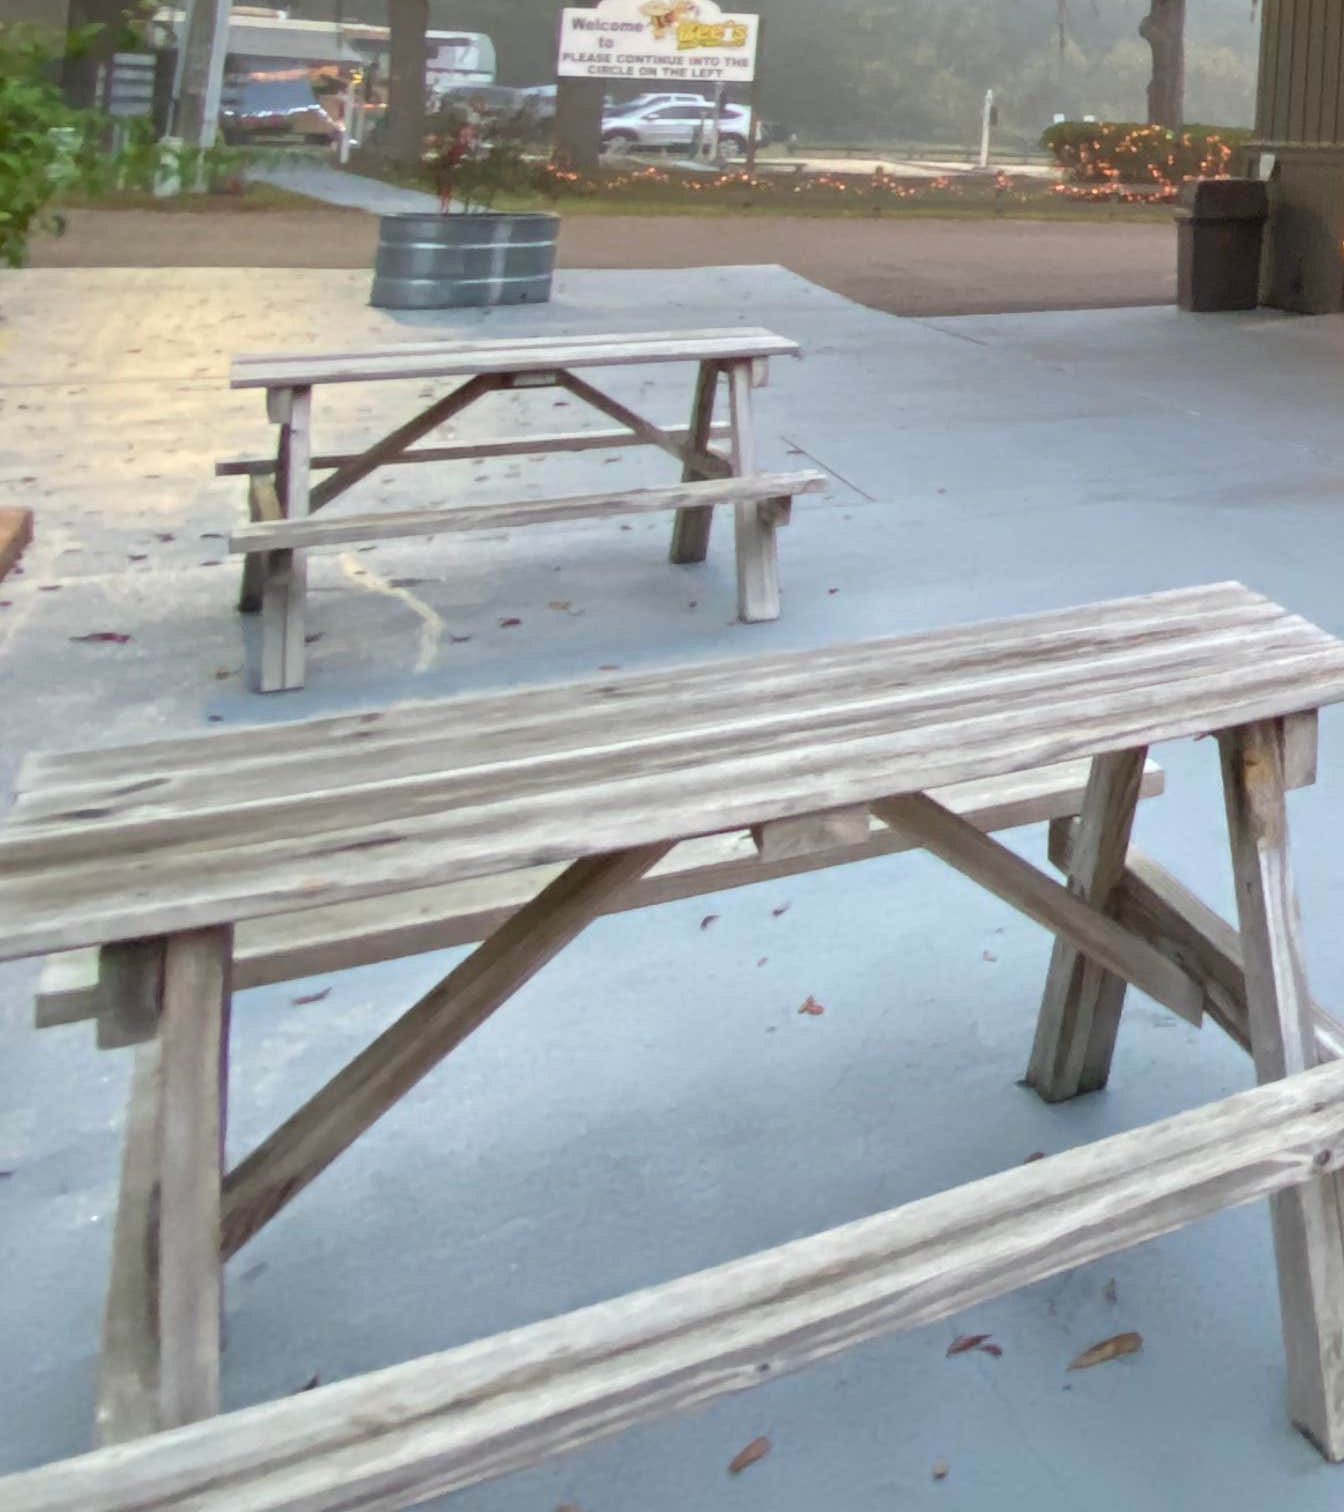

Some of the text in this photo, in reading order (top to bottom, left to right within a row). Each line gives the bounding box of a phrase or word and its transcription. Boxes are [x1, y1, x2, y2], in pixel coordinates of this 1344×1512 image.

[572, 17, 643, 33] Welcome
[598, 37, 614, 49] to
[562, 53, 748, 68] PLEASE CONTINUE INTO THE
[588, 66, 722, 79] CIRCLE ON THE LEFT
